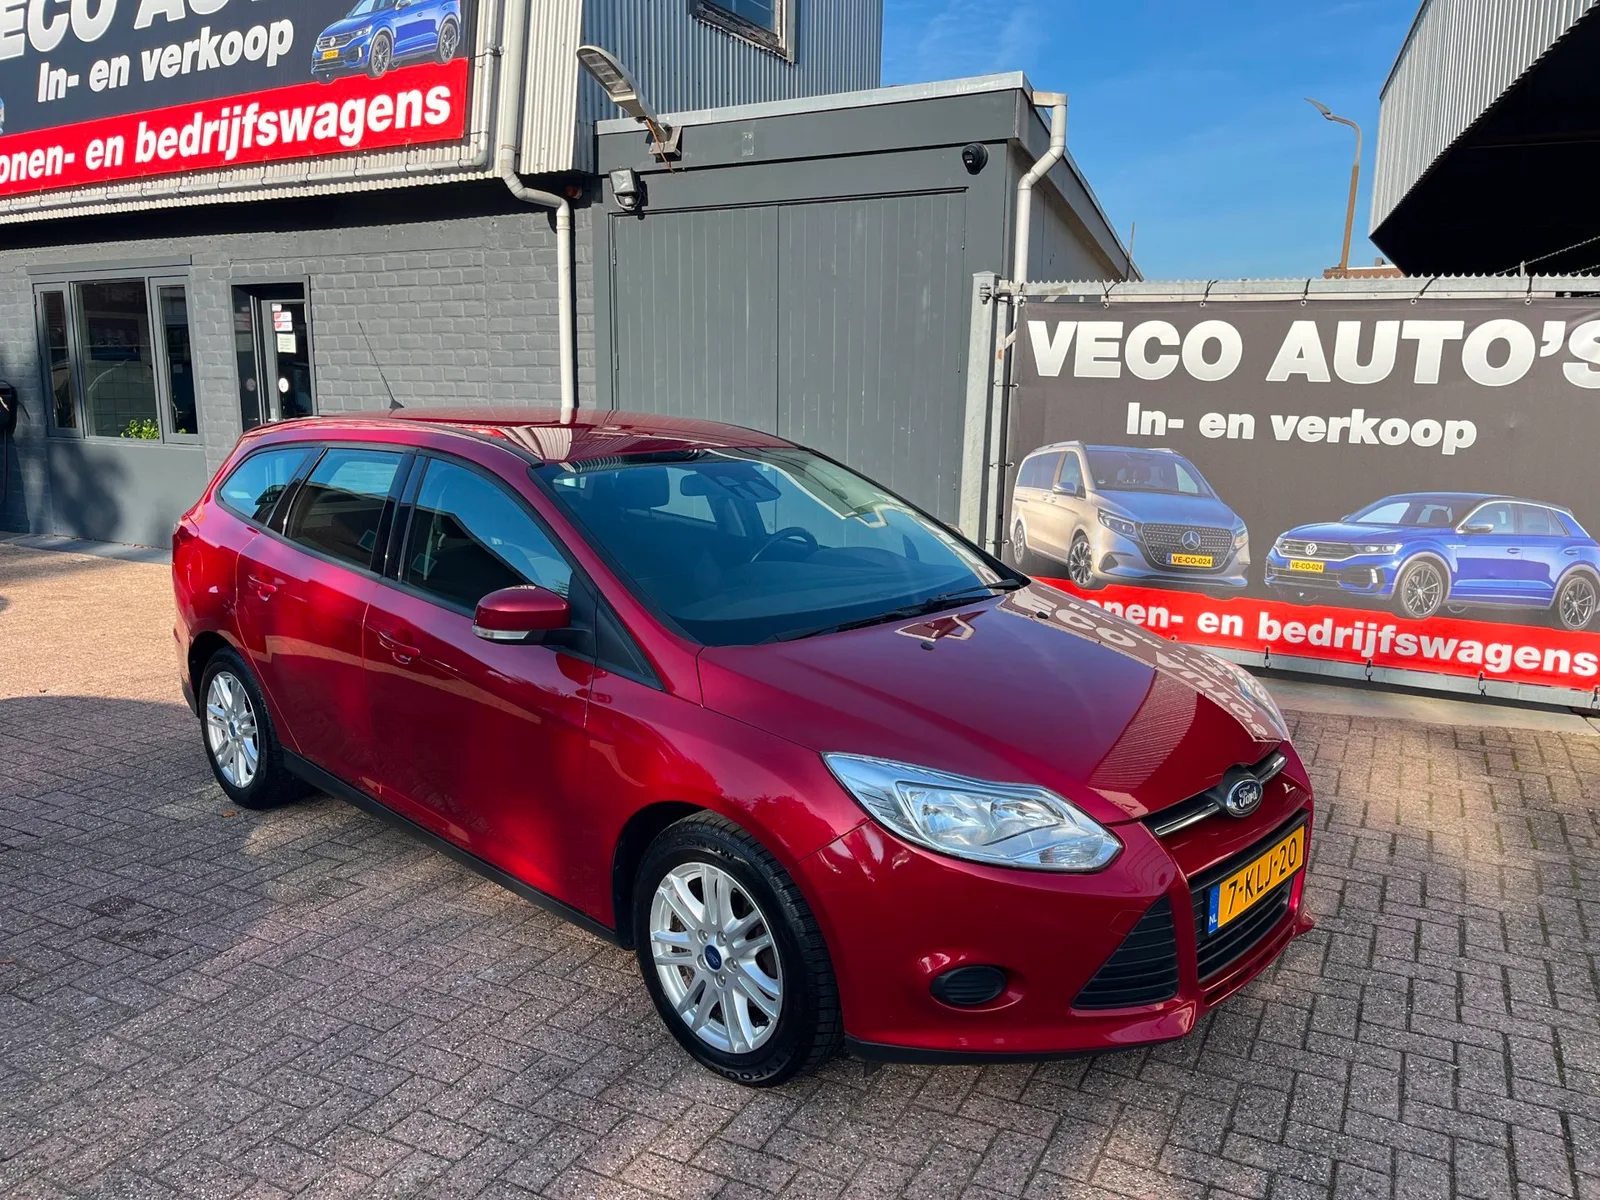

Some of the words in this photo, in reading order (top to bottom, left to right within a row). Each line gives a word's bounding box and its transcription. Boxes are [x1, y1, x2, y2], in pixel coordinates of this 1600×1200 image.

[37, 61, 79, 103] In-
[89, 54, 130, 93] en
[140, 18, 294, 83] verkoop
[84, 132, 124, 169] en
[134, 85, 452, 161] bedrijfswagens
[1026, 318, 1244, 383] VECO
[1264, 317, 1600, 390] AUTO'S
[1125, 401, 1185, 436] In-
[1199, 408, 1256, 441] en
[1270, 407, 1478, 456] verkoop
[1171, 554, 1212, 566] VE-CO-024
[1290, 561, 1323, 571] VE-CO-024
[1197, 611, 1244, 637] en
[1257, 611, 1599, 677] bedrijfswagens
[1238, 785, 1259, 808] Ford
[1226, 837, 1298, 916] 7-KLJ-20
[1208, 913, 1218, 924] NL
